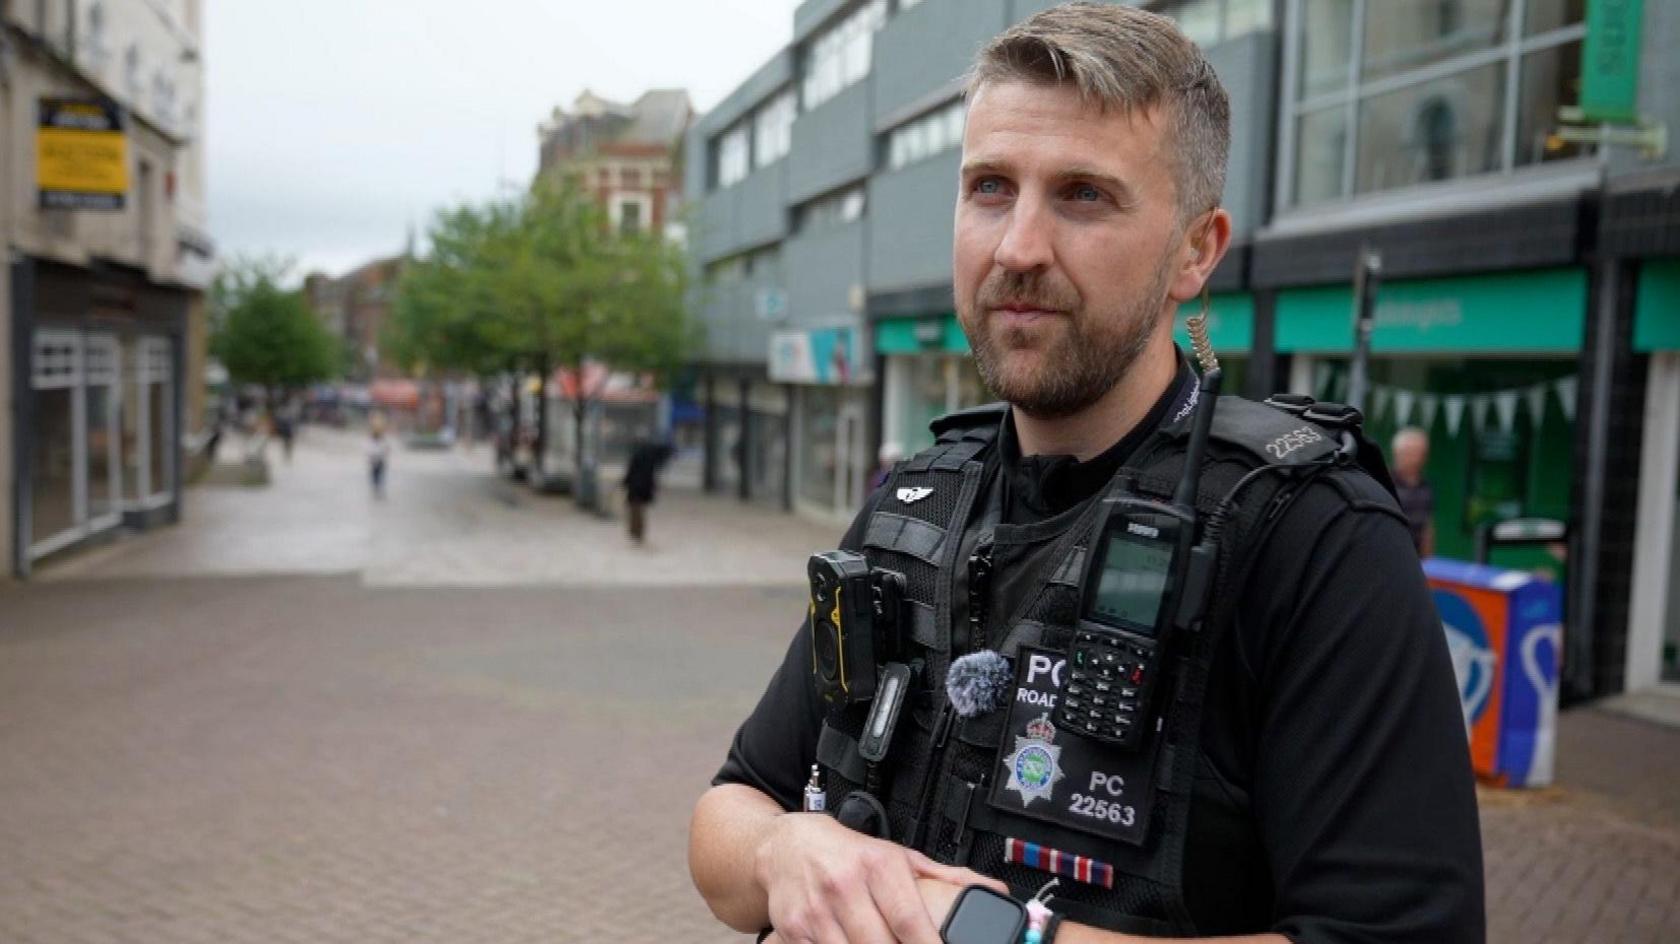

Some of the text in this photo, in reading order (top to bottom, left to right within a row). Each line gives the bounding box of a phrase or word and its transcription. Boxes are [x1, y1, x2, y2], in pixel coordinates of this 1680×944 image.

[1265, 425, 1322, 459] 22563
[1089, 771, 1125, 796] PC
[1068, 793, 1136, 827] 22563
